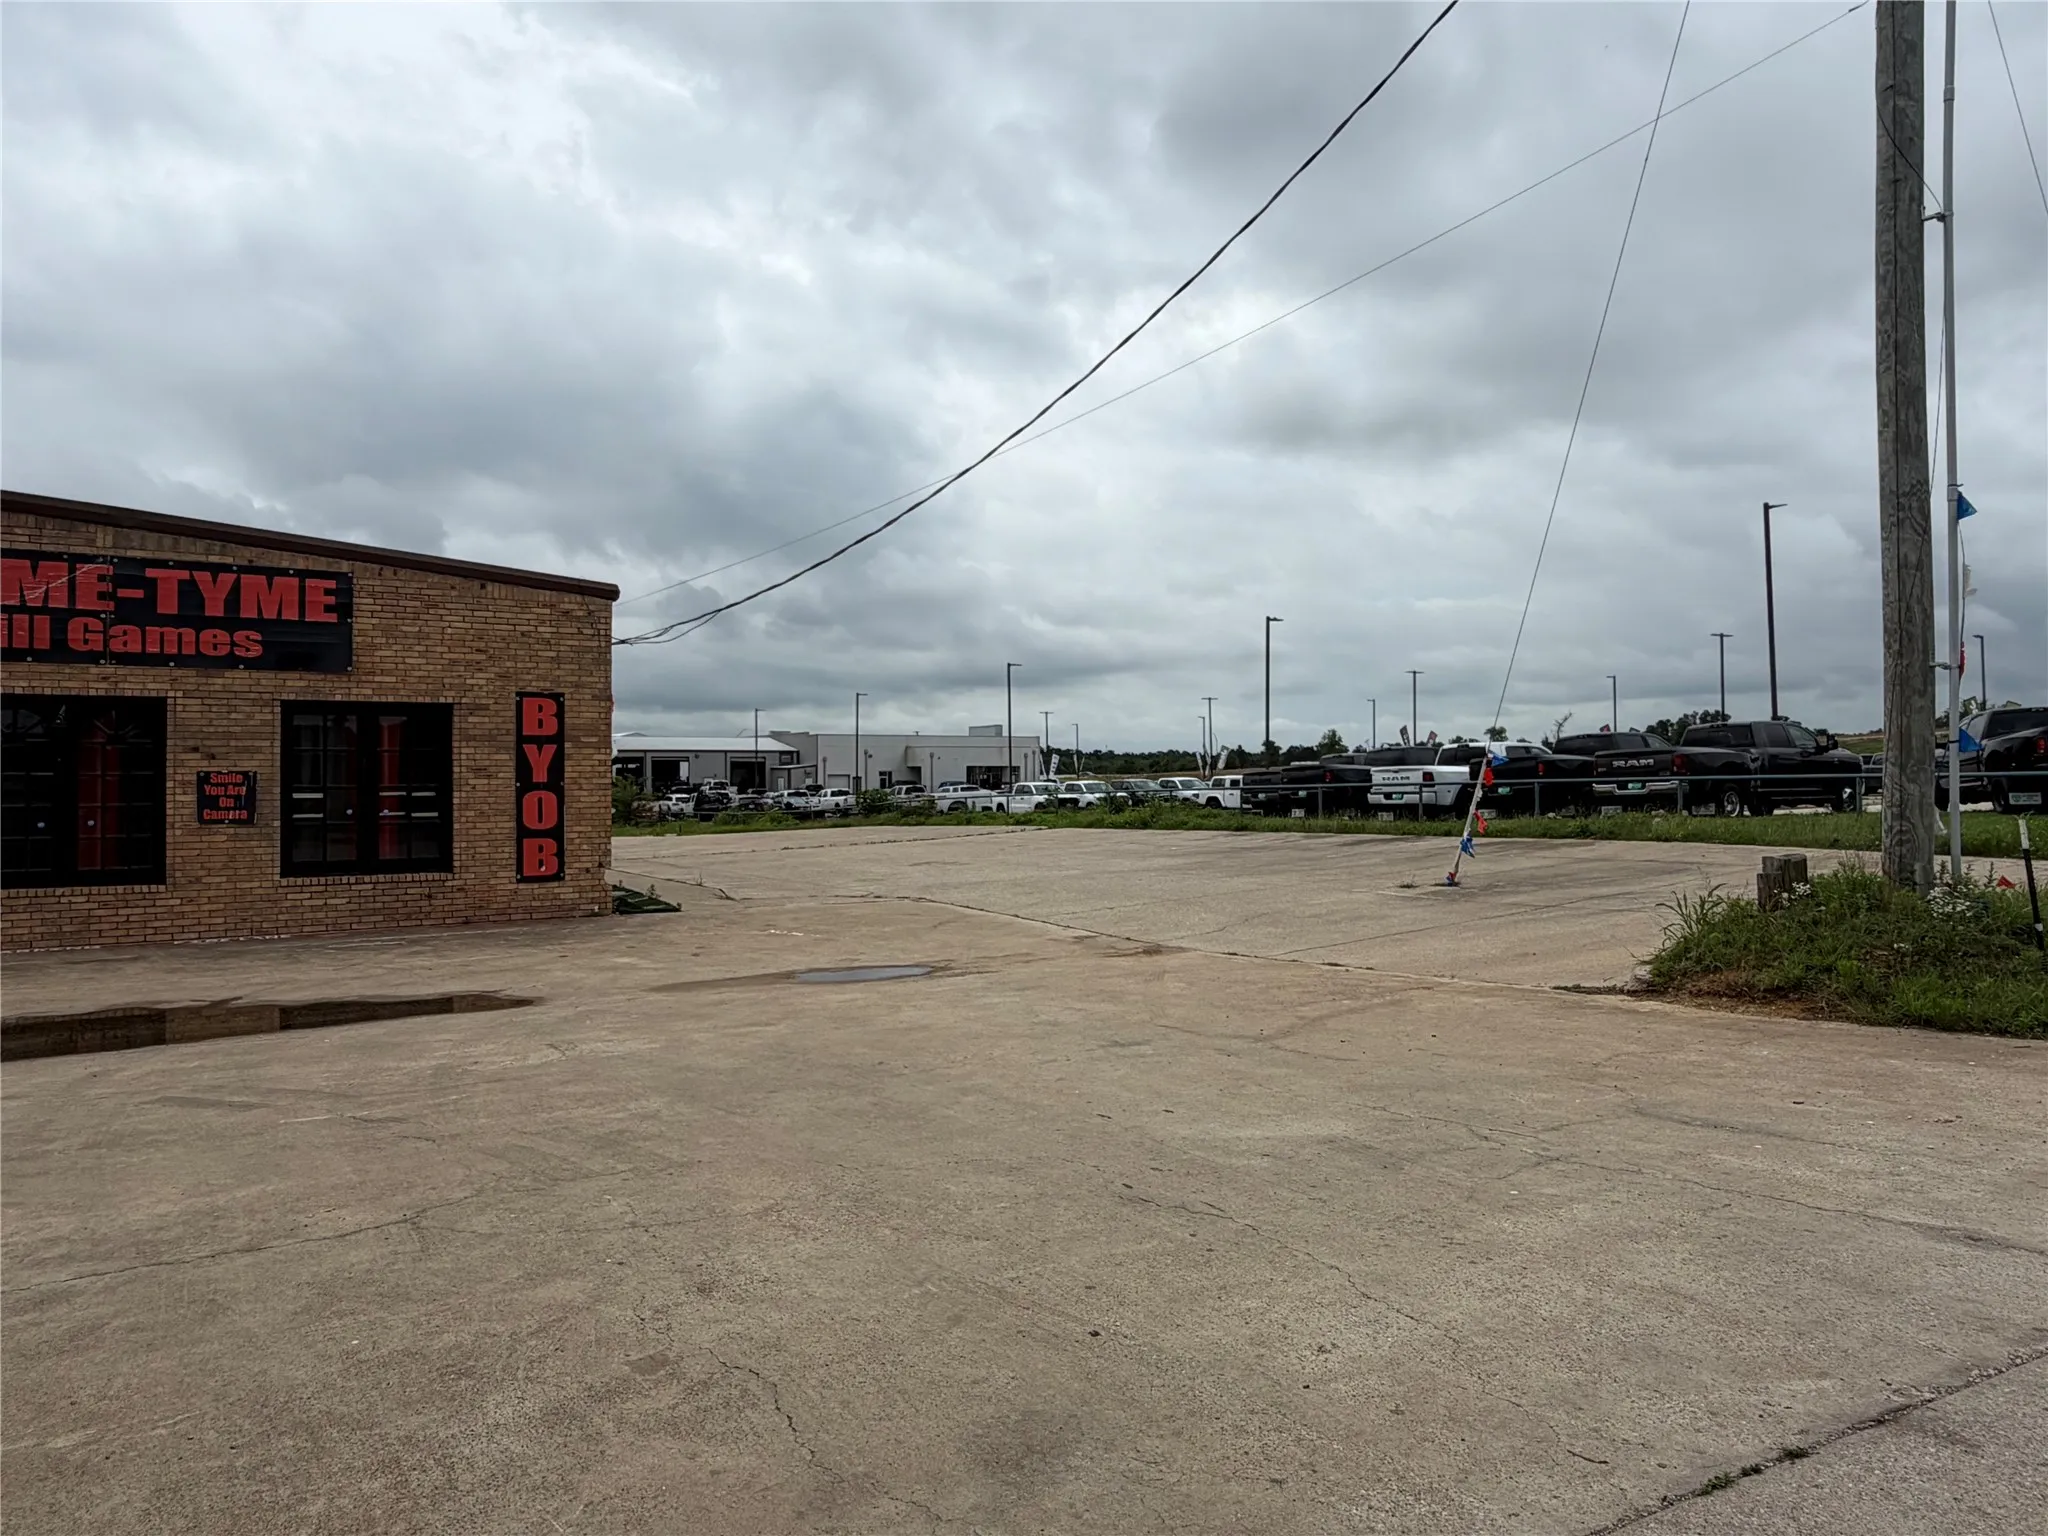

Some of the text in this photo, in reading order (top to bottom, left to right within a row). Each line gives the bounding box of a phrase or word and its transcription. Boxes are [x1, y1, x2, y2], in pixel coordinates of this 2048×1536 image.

[0, 558, 337, 622] ME-TYME
[67, 617, 263, 657] Games
[1612, 759, 1654, 768] RAM
[210, 772, 243, 783] Smile
[204, 784, 246, 795] You Are
[522, 697, 558, 876] BYOB
[219, 796, 235, 807] On
[203, 808, 248, 820] Camera
